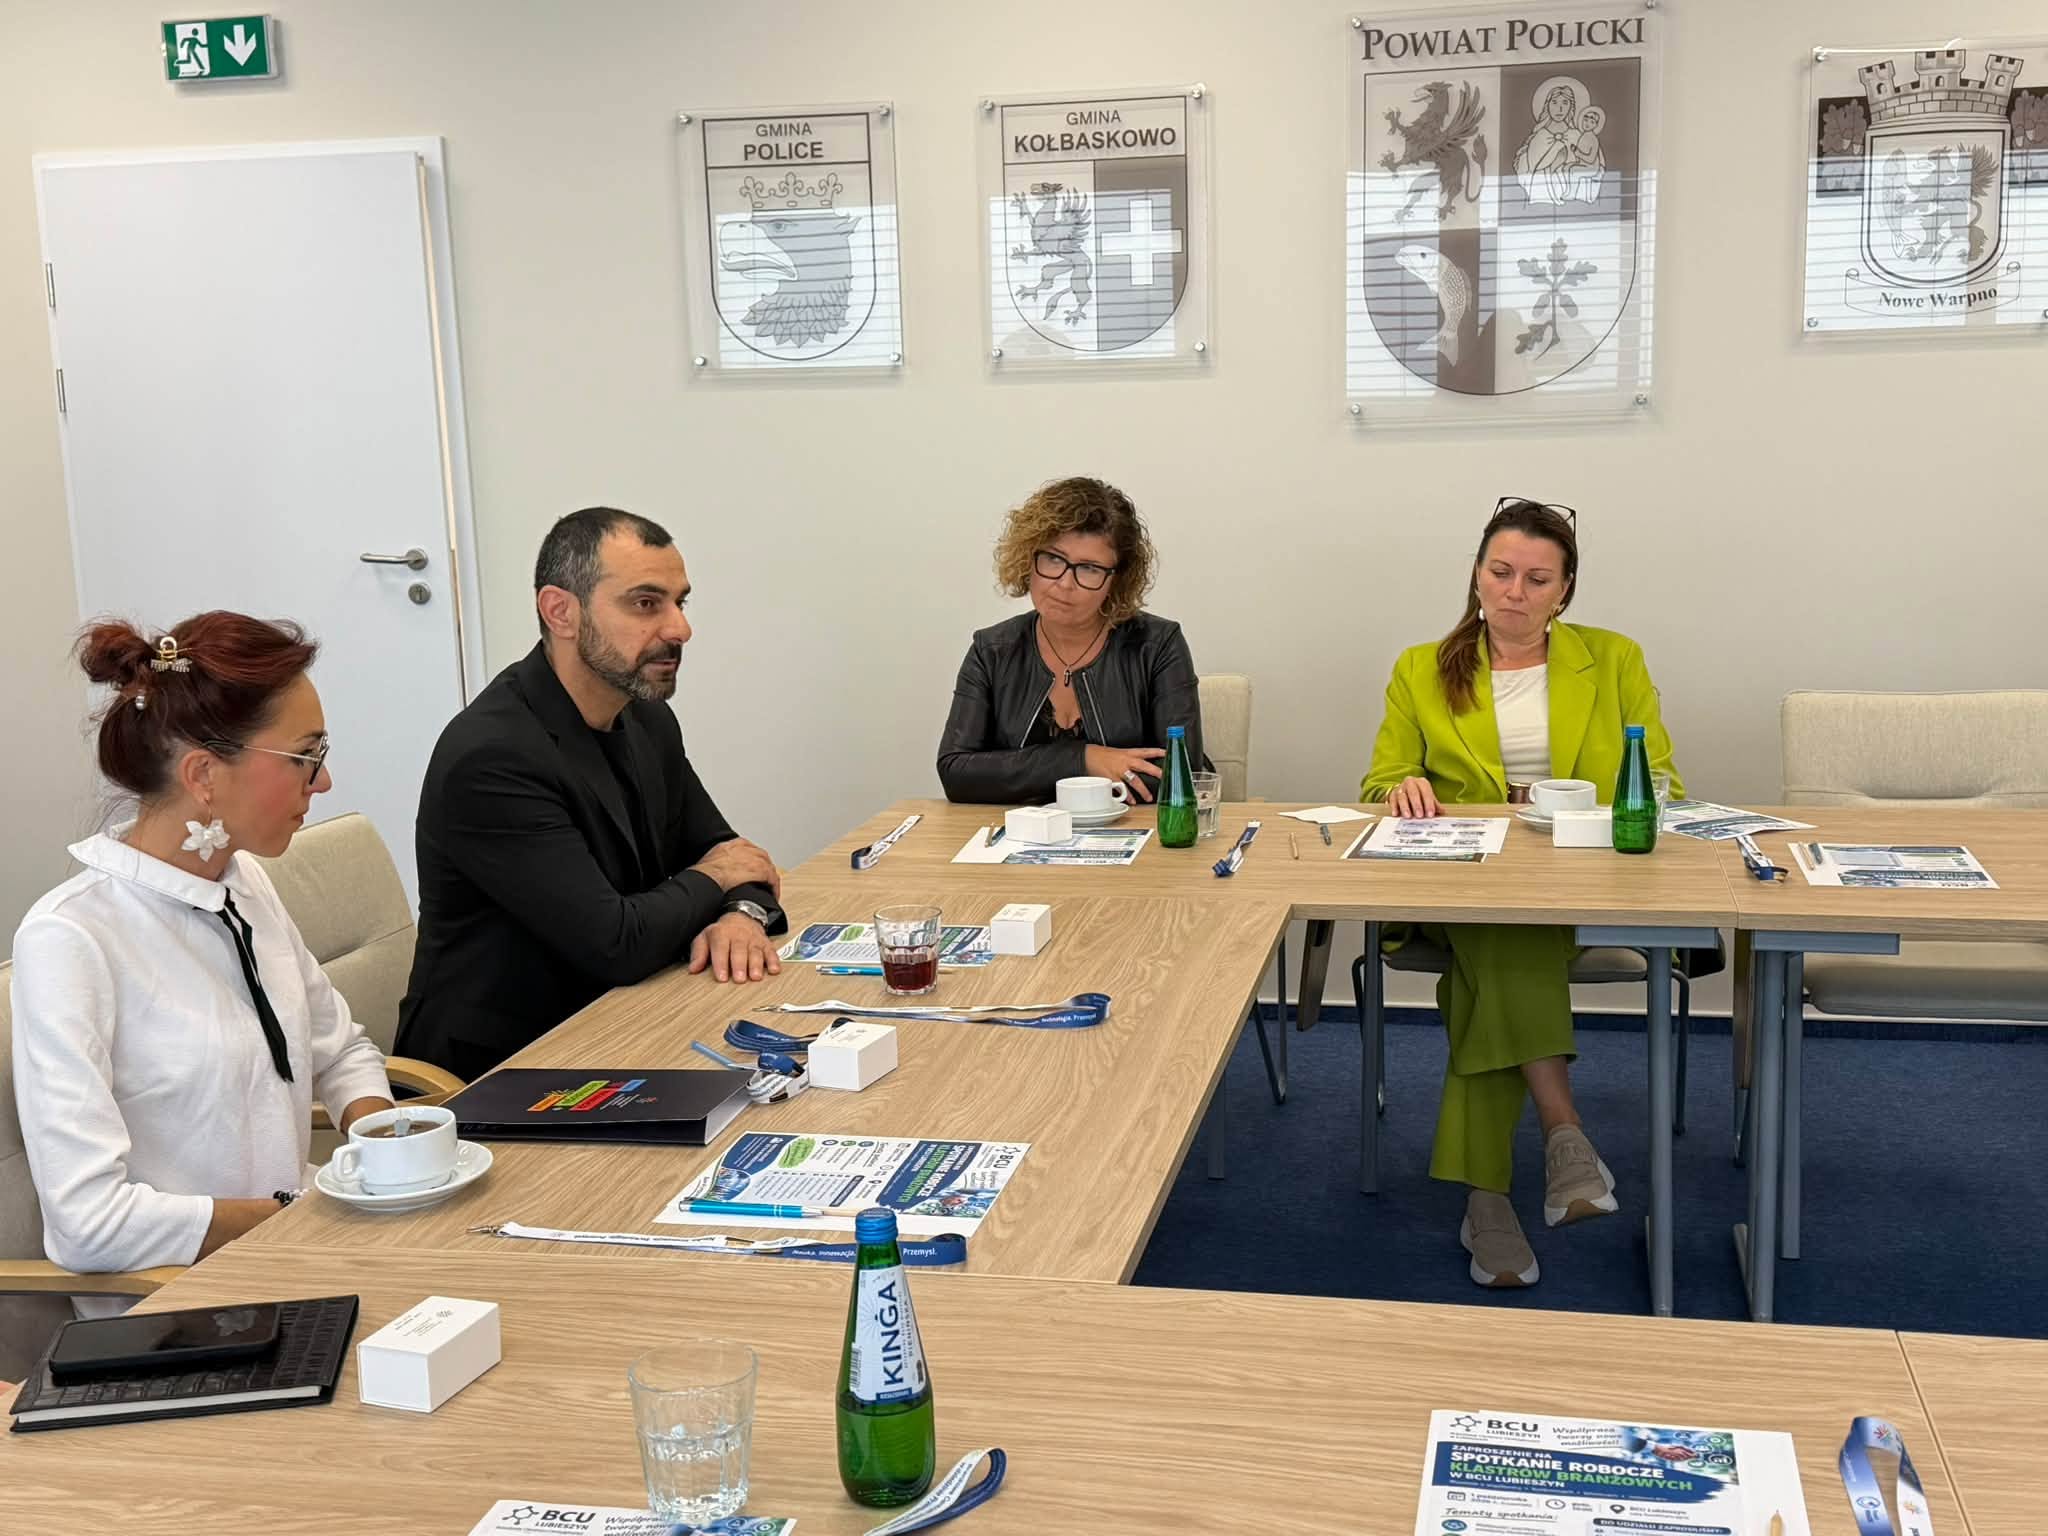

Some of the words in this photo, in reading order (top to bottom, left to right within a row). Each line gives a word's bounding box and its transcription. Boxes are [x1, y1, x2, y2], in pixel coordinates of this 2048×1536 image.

[1361, 27, 1497, 60] POWIAT
[1504, 17, 1646, 51] POLICKI
[1065, 109, 1122, 126] GMINA
[755, 121, 813, 137] GMINA
[1014, 127, 1177, 153] KOŁBASKOWO
[743, 141, 824, 161] POLICE
[1880, 292, 1924, 308] Nowe
[1929, 287, 1998, 307] Warpno
[1486, 1418, 1540, 1433] BCU
[1451, 1444, 1533, 1459] ZAPROSZENIE
[1450, 1451, 1563, 1471] SPOTKANIE
[1568, 1462, 1665, 1479] ROBOCZE
[1450, 1461, 1552, 1481] KLASTRÓW
[1556, 1470, 1693, 1491] BRANŻOWYCH
[1450, 1472, 1463, 1481] W
[1465, 1473, 1493, 1483] BCU
[1495, 1477, 1566, 1489] LUBIESZYN
[541, 1509, 597, 1524] BCU
[1445, 1507, 1493, 1518] Tematy
[535, 1521, 591, 1531] LUBIESZYN
